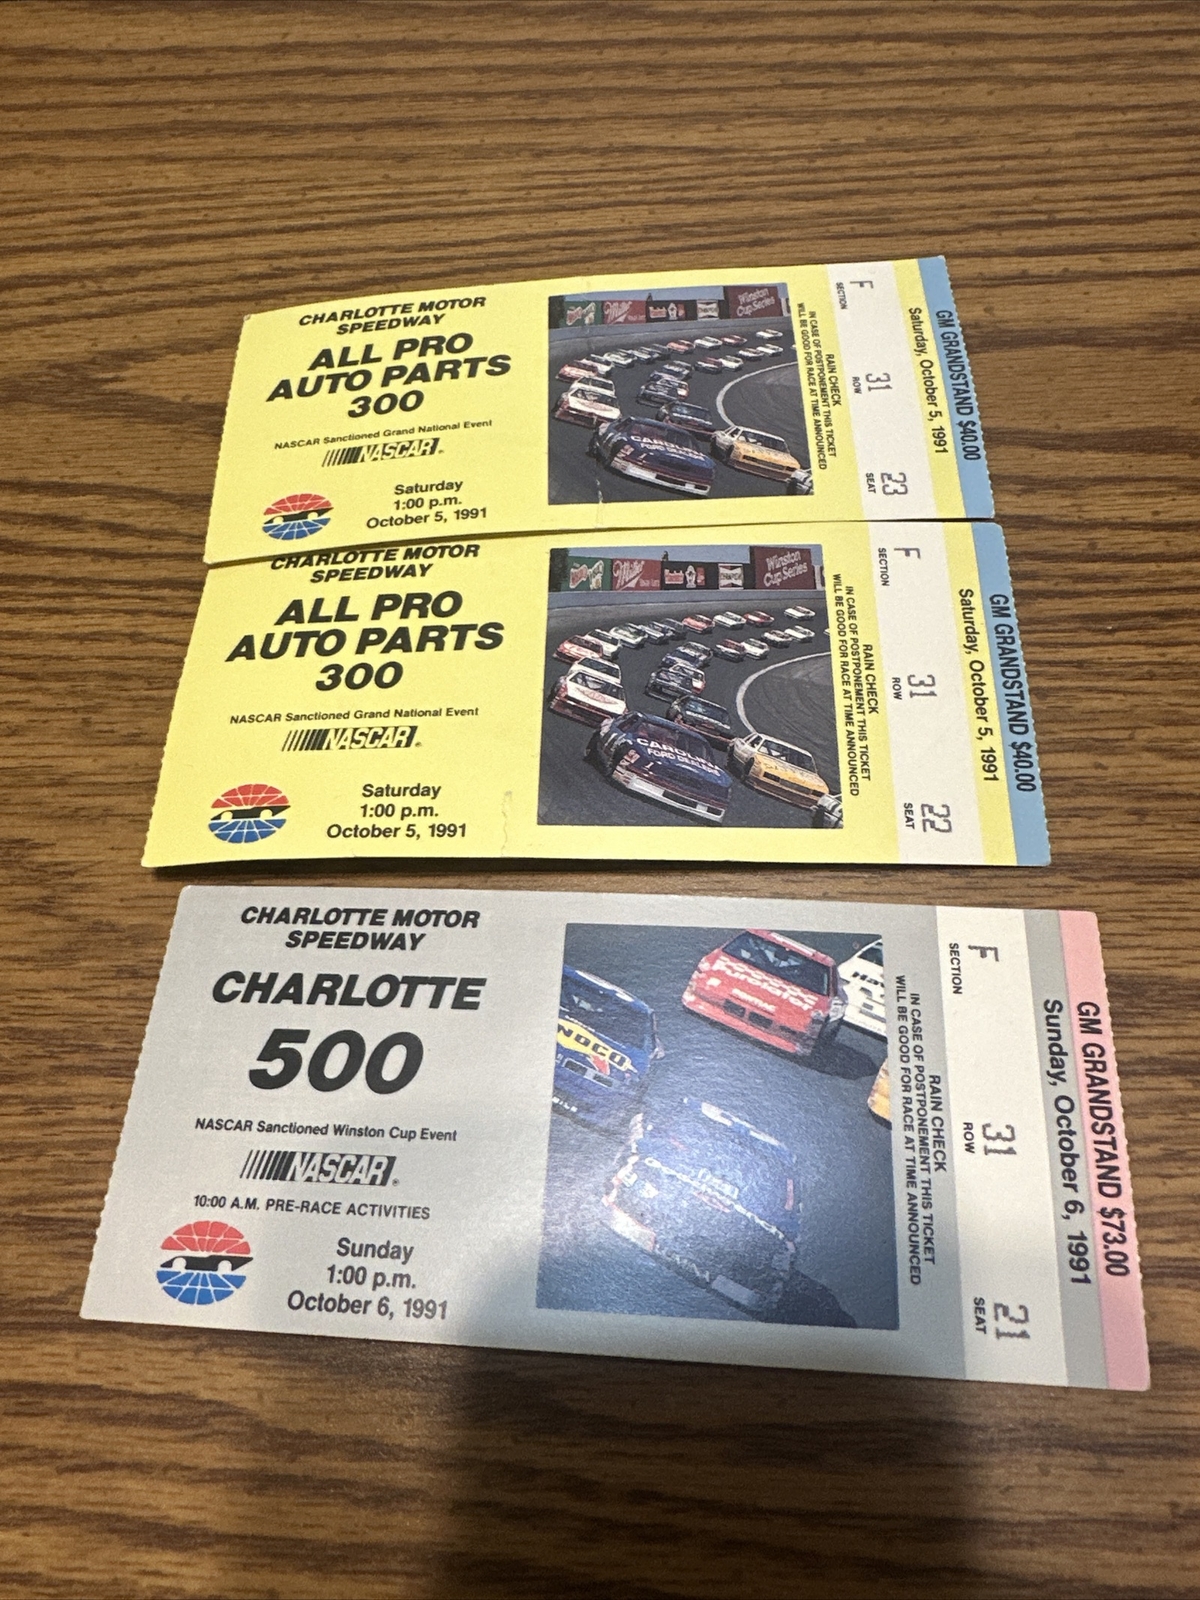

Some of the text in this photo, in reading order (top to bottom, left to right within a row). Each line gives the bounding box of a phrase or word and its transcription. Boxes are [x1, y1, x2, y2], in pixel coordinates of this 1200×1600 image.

[836, 282, 848, 310] SECTION
[850, 280, 874, 289] F
[299, 296, 487, 326] CHARLOTTE MOTOR
[336, 313, 445, 335] SPEEDWAY
[307, 332, 474, 371] ALL PRO
[266, 354, 512, 402] AUTO PARTS
[808, 311, 837, 457] IN CASE OF POSTPONEMENT THIS TICKET
[825, 353, 842, 406] RAIN CHECK
[852, 376, 862, 394] ROW
[866, 372, 893, 392] 31
[908, 307, 949, 453] Saturday, October 5, 1991
[936, 310, 982, 460] GM GRANDSTAND $40.00
[348, 390, 424, 418] 300
[274, 419, 492, 450] NASCAR Sanctioned Grand National Event
[358, 438, 438, 463] NASCAR
[394, 480, 463, 496] Saturday
[865, 472, 877, 494] SEAT
[880, 472, 908, 496] 23
[394, 495, 462, 510] 1:00 p.m.
[366, 507, 487, 529] October 5, 1991
[270, 544, 480, 570] CHARLOTTE MOTOR
[878, 547, 890, 587] SECTION
[894, 548, 921, 559] F
[310, 563, 433, 583] SPEEDWAY
[274, 590, 463, 625] ALL PRO
[225, 622, 505, 663] AUTO PARTS
[316, 661, 404, 692] 300
[833, 573, 860, 796] WILL BE GOOD FOR RACE AT TIME ANNOUNCED
[845, 586, 871, 781] IN CASE OF POSTPONEMENT THIS TICKET
[862, 644, 879, 714] RAIN CHECK
[891, 677, 902, 700] ROW
[907, 674, 937, 699] 31
[958, 588, 1000, 781] Saturday, October 5, 1991
[989, 594, 1037, 792] GM GRANDSTAND $40.00
[230, 707, 479, 725] NASCAR Sanctioned Grand National Event
[323, 726, 415, 750] NASCAR
[362, 784, 441, 800] Saturday
[360, 804, 440, 820] 1:00 p.m.
[903, 802, 916, 830] SEAT
[920, 803, 953, 834] 22
[326, 823, 467, 841] October 5, 1991
[241, 906, 481, 929] CHARLOTTE MOTOR
[285, 930, 426, 951] SPEEDWAY
[968, 944, 1000, 962] F
[949, 942, 963, 995] SECTION
[212, 970, 487, 1010] CHARLOTTE
[712, 960, 814, 1011] Purolator
[248, 1028, 424, 1095] 500
[195, 1117, 457, 1142] NASCAR Sanctioned Winston Cup Event
[895, 975, 921, 1286] WILL BE GOOD FOR RACE AT TIME ANNOUNCED
[910, 993, 935, 1265] IN CASE OF POSTPONEMENT THIS TICKET
[929, 1074, 947, 1173] RAIN CHECK
[963, 1122, 975, 1154] ROW
[982, 1123, 1017, 1156] 31
[1043, 999, 1092, 1285] Sunday, October 6, 1991
[1077, 1001, 1131, 1277] GM GRANDSTAND $73.00
[288, 1152, 392, 1186] NASCAR
[193, 1195, 431, 1220] 10:00 A.M. PRE-RACE ACTIVITIES
[337, 1237, 415, 1263] Sunday
[327, 1265, 417, 1291] 1:00 p.m.
[287, 1290, 448, 1320] October 6, 1991
[973, 1297, 987, 1335] SEAT
[993, 1302, 1031, 1340] 21
